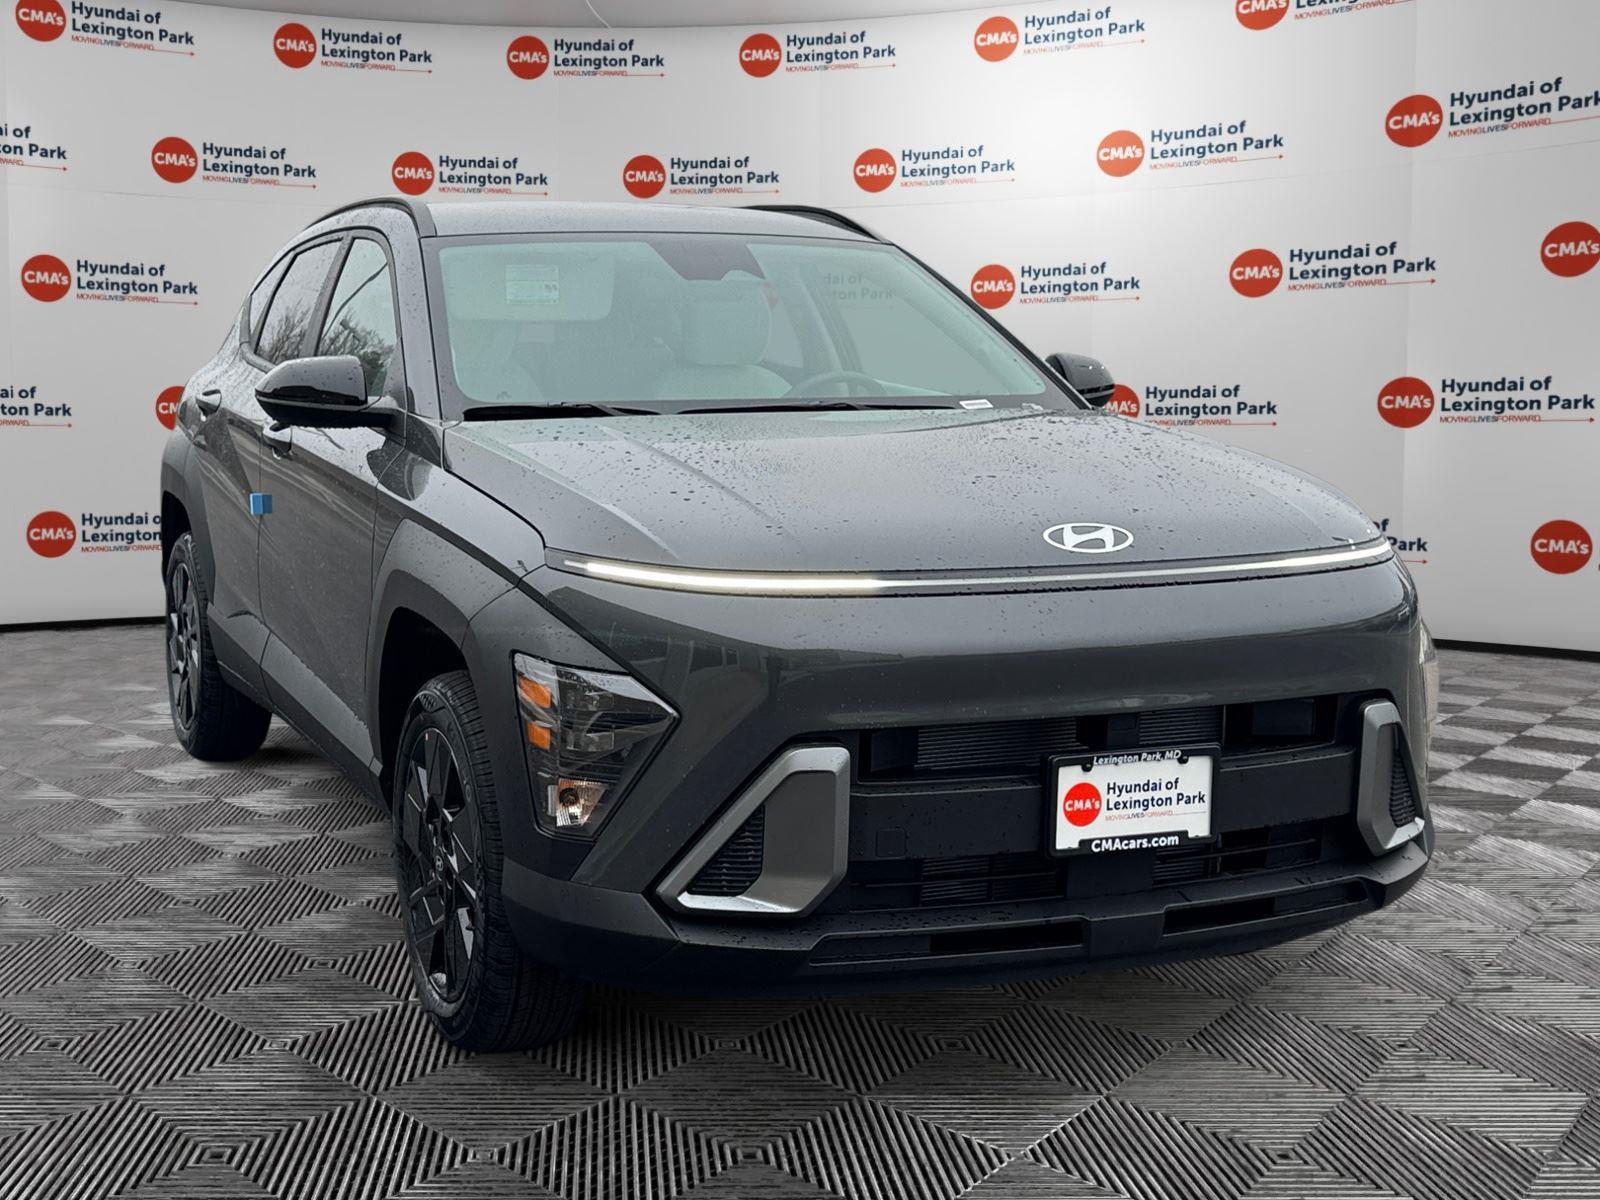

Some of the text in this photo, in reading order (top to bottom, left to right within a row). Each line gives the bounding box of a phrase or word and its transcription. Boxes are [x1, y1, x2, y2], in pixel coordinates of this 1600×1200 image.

[18, 8, 65, 26] CMA's
[72, 1, 162, 24] Hyundai of
[1024, 6, 1111, 30] Hyundai of
[72, 18, 194, 45] Lexington Park
[322, 28, 402, 45] Hyundai of
[786, 31, 865, 49] Hyundai of
[977, 31, 1016, 46] CMA's
[1024, 19, 1145, 44] Lexington Park
[276, 38, 314, 53] CMA's
[322, 44, 432, 63] Lexington Park
[554, 39, 634, 55] Hyundai of
[509, 51, 547, 64] CMA's
[554, 54, 664, 71] Lexington Park
[742, 49, 779, 61] CMA's
[786, 45, 896, 64] Lexington Park
[1450, 76, 1562, 108] Hyundai of
[1388, 111, 1441, 130] CMA's
[1450, 102, 1550, 126] Lexington
[12, 126, 31, 139] of
[1150, 121, 1246, 145] Hyundai of
[29, 143, 67, 160] Park
[203, 142, 286, 160] Hyundai of
[902, 145, 983, 164] Hyundai of
[1099, 145, 1141, 161] CMA's
[1150, 135, 1284, 159] Lexington Park
[154, 152, 195, 167] CMA's
[440, 156, 518, 171] Hyundai of
[670, 156, 749, 173] Hyundai of
[203, 159, 316, 179] Lexington Park
[394, 167, 432, 180] CMA's
[625, 171, 663, 183] CMA's
[856, 164, 894, 177] CMA's
[902, 159, 1015, 179] Lexington Park
[440, 172, 548, 188] Lexington Park
[670, 171, 780, 188] Lexington Park
[1289, 242, 1397, 265] Hyundai of
[1544, 240, 1600, 257] CMA's
[76, 260, 165, 277] Hyundai of
[1020, 262, 1107, 281] Hyundai of
[1232, 265, 1280, 280] CMA's
[1289, 258, 1436, 281] Lexington Park
[24, 270, 68, 285] CMA's
[76, 277, 198, 296] Lexington Park
[974, 280, 1013, 293] CMA's
[1020, 278, 1140, 297] Lexington Park
[18, 386, 37, 399] of
[1146, 384, 1241, 403] Hyundai of
[1440, 377, 1552, 397] Hyundai of
[34, 403, 72, 416] Park
[1106, 401, 1137, 413] MA's
[1381, 394, 1431, 409] CMA's
[1440, 395, 1594, 415] Lexington Park
[1146, 402, 1278, 420] Lexington Park
[81, 512, 149, 529] Hyundai
[30, 528, 74, 540] CMA's
[82, 529, 162, 544] Lexington
[1534, 538, 1589, 554] CMA's
[1093, 755, 1139, 765] Lexington
[1165, 750, 1181, 760] MD
[1107, 777, 1179, 797] Hyundai of
[1065, 798, 1100, 812] CMA's
[1106, 791, 1205, 811] Lexington Park
[1091, 835, 1179, 852] CMAcars.com
